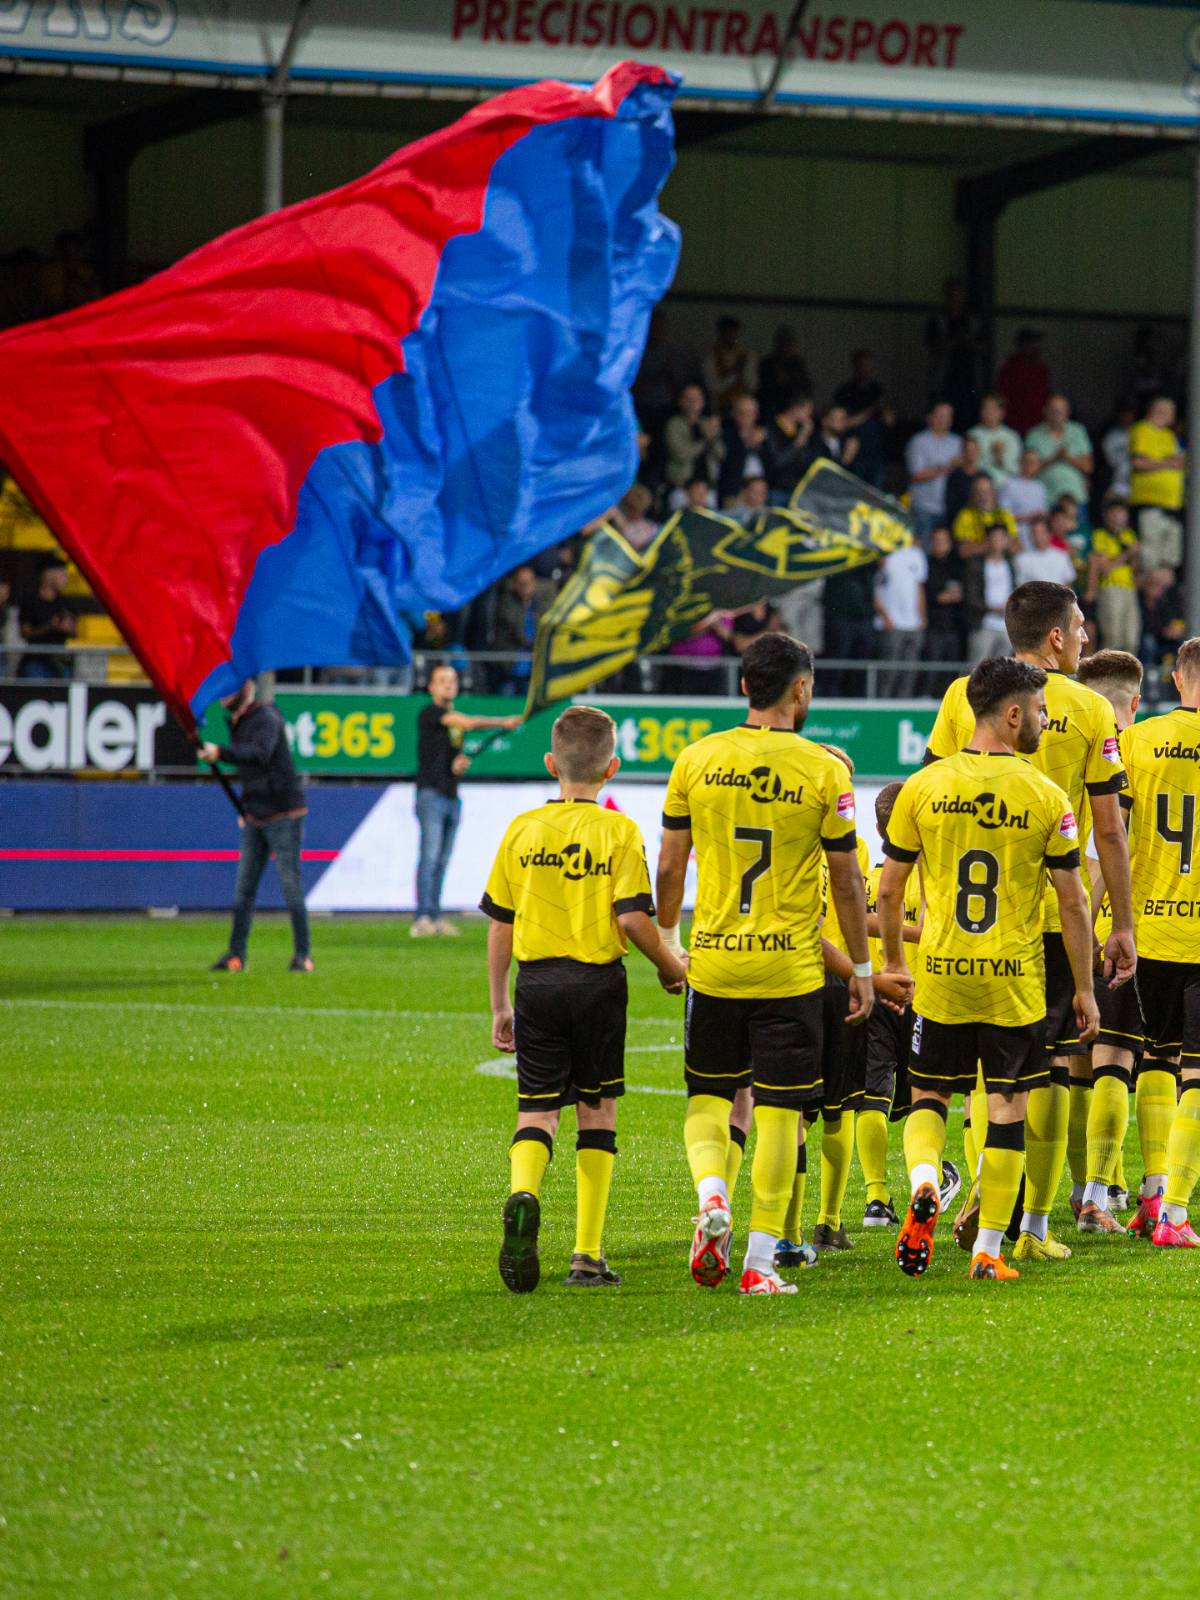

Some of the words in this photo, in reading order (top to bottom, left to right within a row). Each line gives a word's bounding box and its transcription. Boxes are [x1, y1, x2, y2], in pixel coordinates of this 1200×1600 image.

[452, 0, 965, 69] PRECISIONTRANSPORT
[0, 682, 167, 771] aler
[286, 711, 395, 757] t365
[619, 717, 711, 762] t365
[734, 825, 774, 915] 7
[955, 848, 1000, 934] 8
[695, 931, 797, 951] BETCITY.NL
[926, 955, 1025, 977] BETCITY.NL
